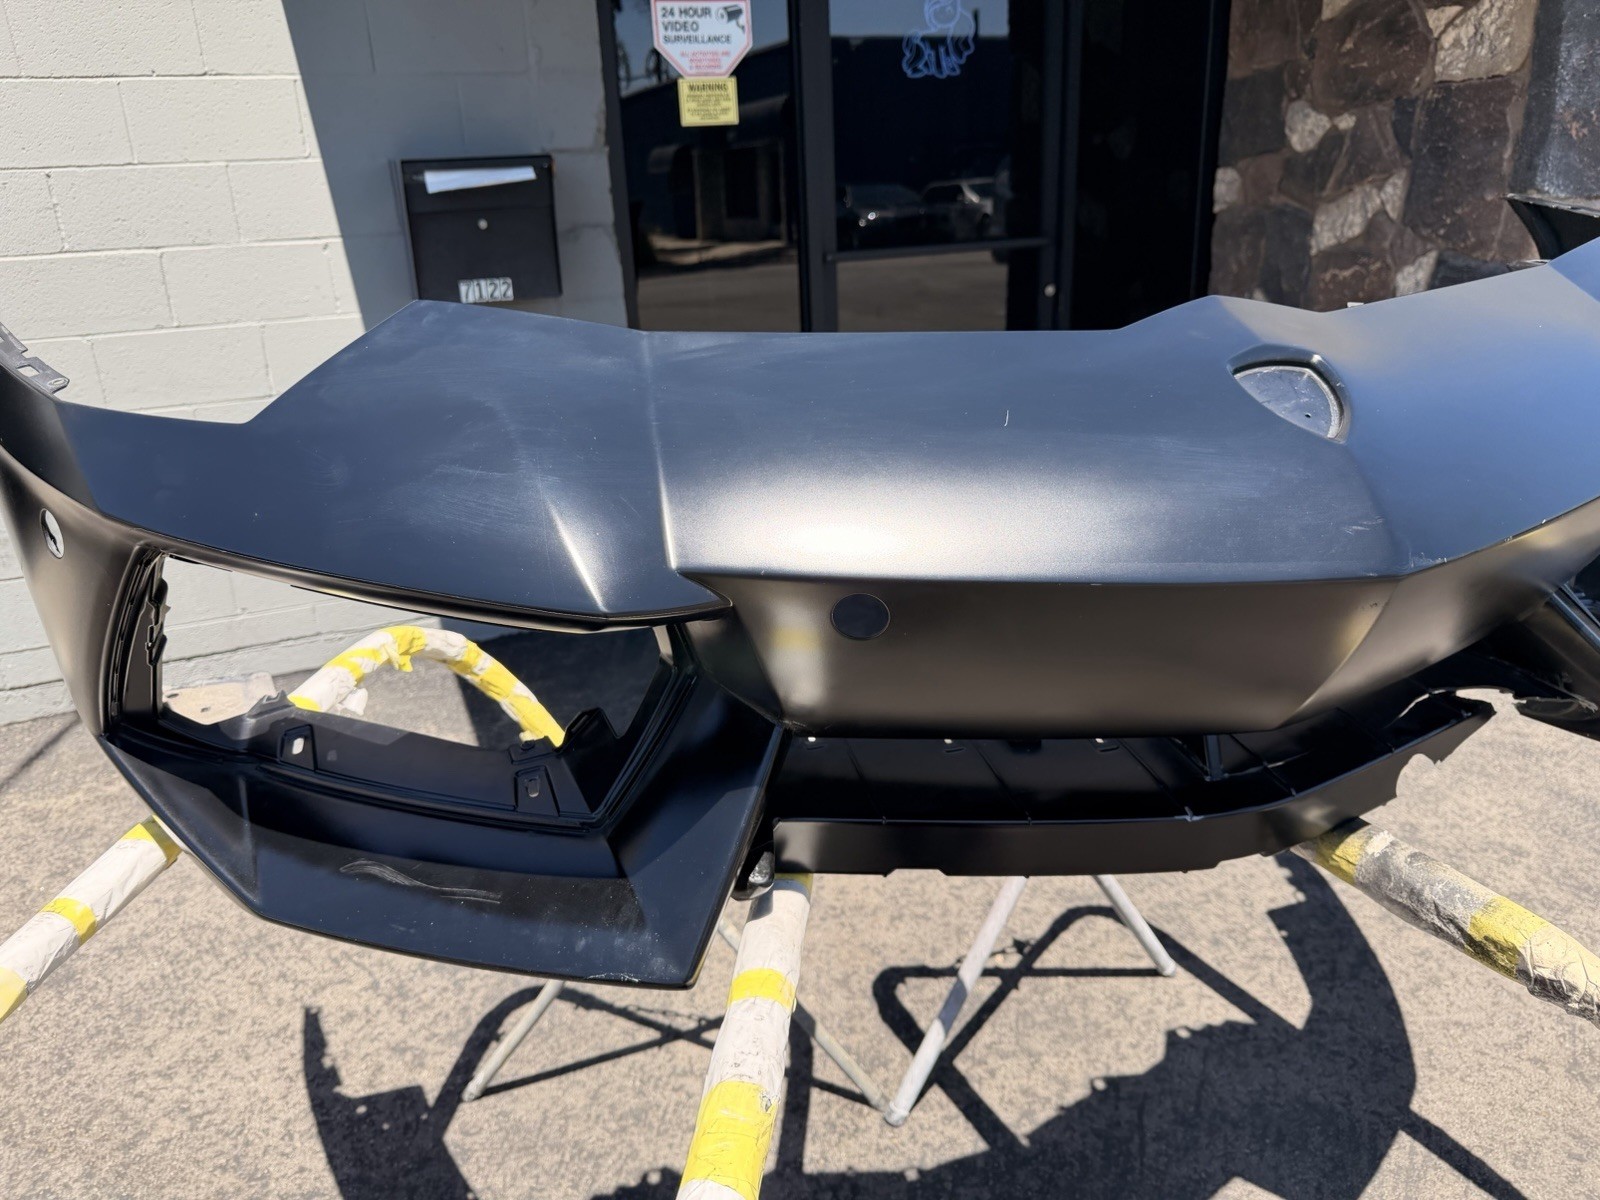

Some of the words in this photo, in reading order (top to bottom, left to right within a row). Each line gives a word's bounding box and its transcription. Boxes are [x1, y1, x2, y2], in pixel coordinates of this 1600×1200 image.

[661, 7, 675, 18] 24
[678, 7, 711, 18] HOUR
[662, 21, 699, 32] VIDEO
[663, 34, 731, 44] SURVEILLANCE
[688, 83, 728, 92] WARNING
[460, 280, 511, 300] 7122
